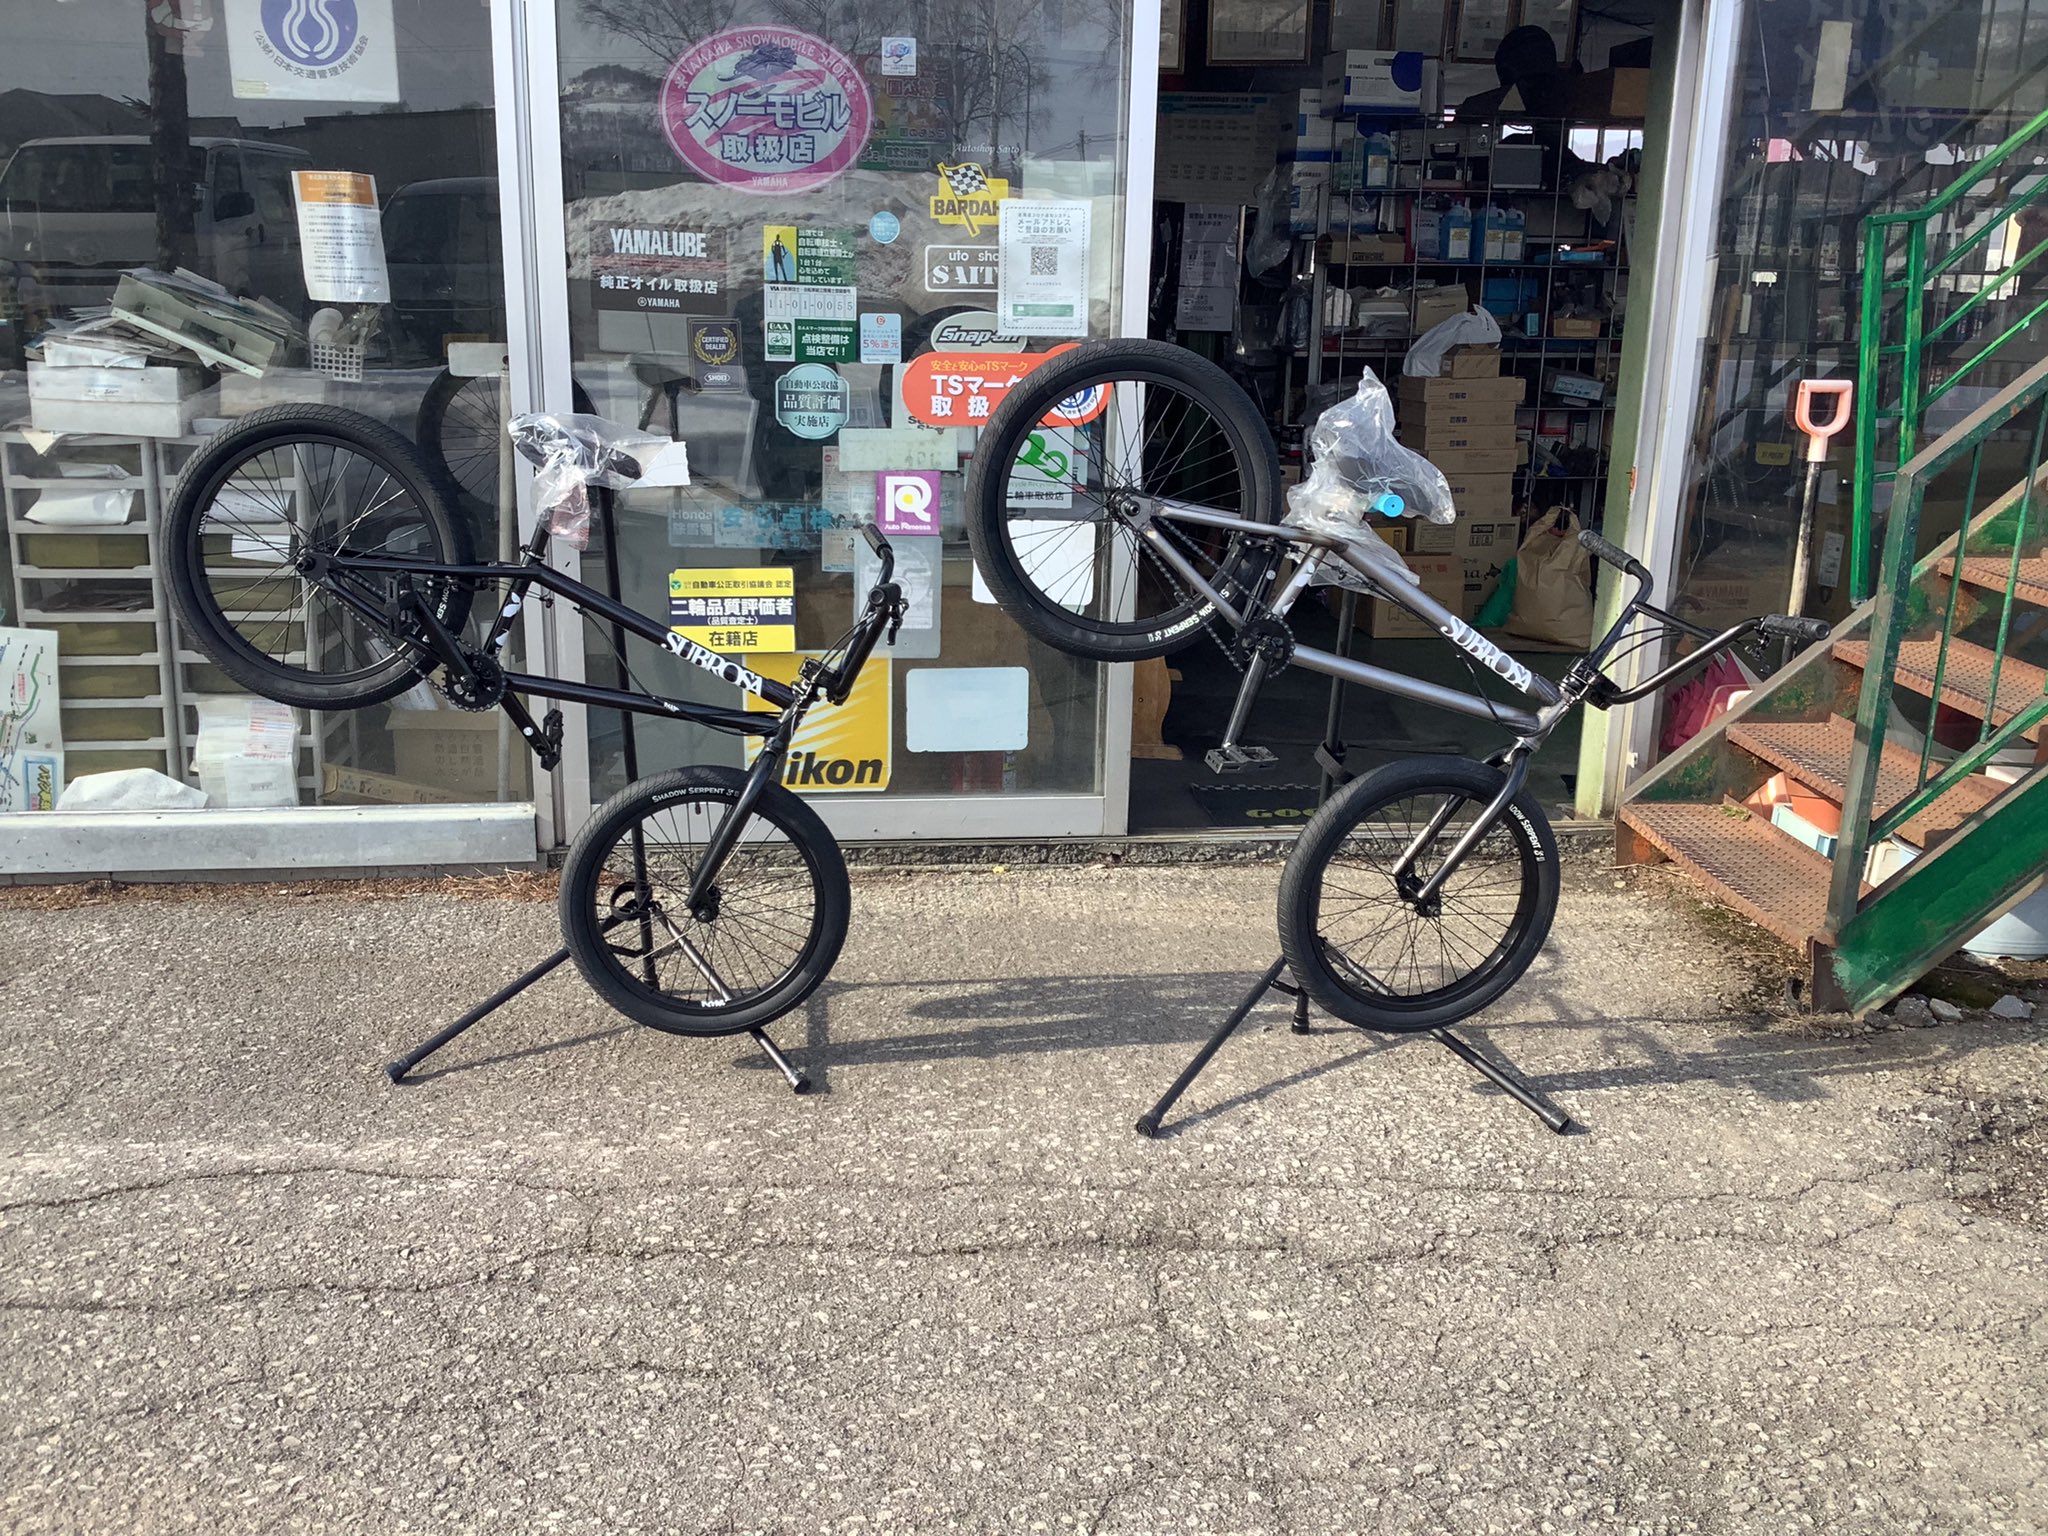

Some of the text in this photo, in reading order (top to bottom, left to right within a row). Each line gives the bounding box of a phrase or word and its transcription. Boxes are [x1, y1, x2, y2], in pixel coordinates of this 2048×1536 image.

[682, 34, 850, 79] YAMAHA SNOWMOBILE SHOP
[684, 92, 853, 132] スノーモビル
[721, 133, 815, 163] 取扱店
[751, 176, 789, 187] YAMAHA
[1018, 218, 1072, 226] メールアドレス
[609, 228, 707, 258] YAMALUBE
[932, 265, 999, 284] SAIT
[600, 275, 719, 294] 純正オイル取扱店
[647, 298, 681, 308] YAMAHA
[801, 333, 850, 345] 点検整備は
[863, 339, 900, 349] 5%還元
[930, 360, 1029, 372] 安全と安心のTSマーク
[707, 374, 728, 383] SHOEI
[785, 379, 839, 390] 自動車公取協
[783, 394, 841, 411] 品質評価
[794, 415, 830, 428] 実施店
[671, 509, 713, 520] Honda
[884, 523, 900, 531] Auto
[692, 581, 773, 589] 自動車公正取引協議会
[776, 580, 792, 589] 認定
[671, 598, 794, 616] 二輪品質評価者
[706, 616, 759, 627] (品質査定士)
[708, 631, 759, 647] 在籍店
[1440, 615, 1532, 694] SUBROSA
[661, 632, 763, 696] SUBROSA
[777, 751, 883, 785] ikon
[652, 786, 725, 803] SHADOW SERPENT
